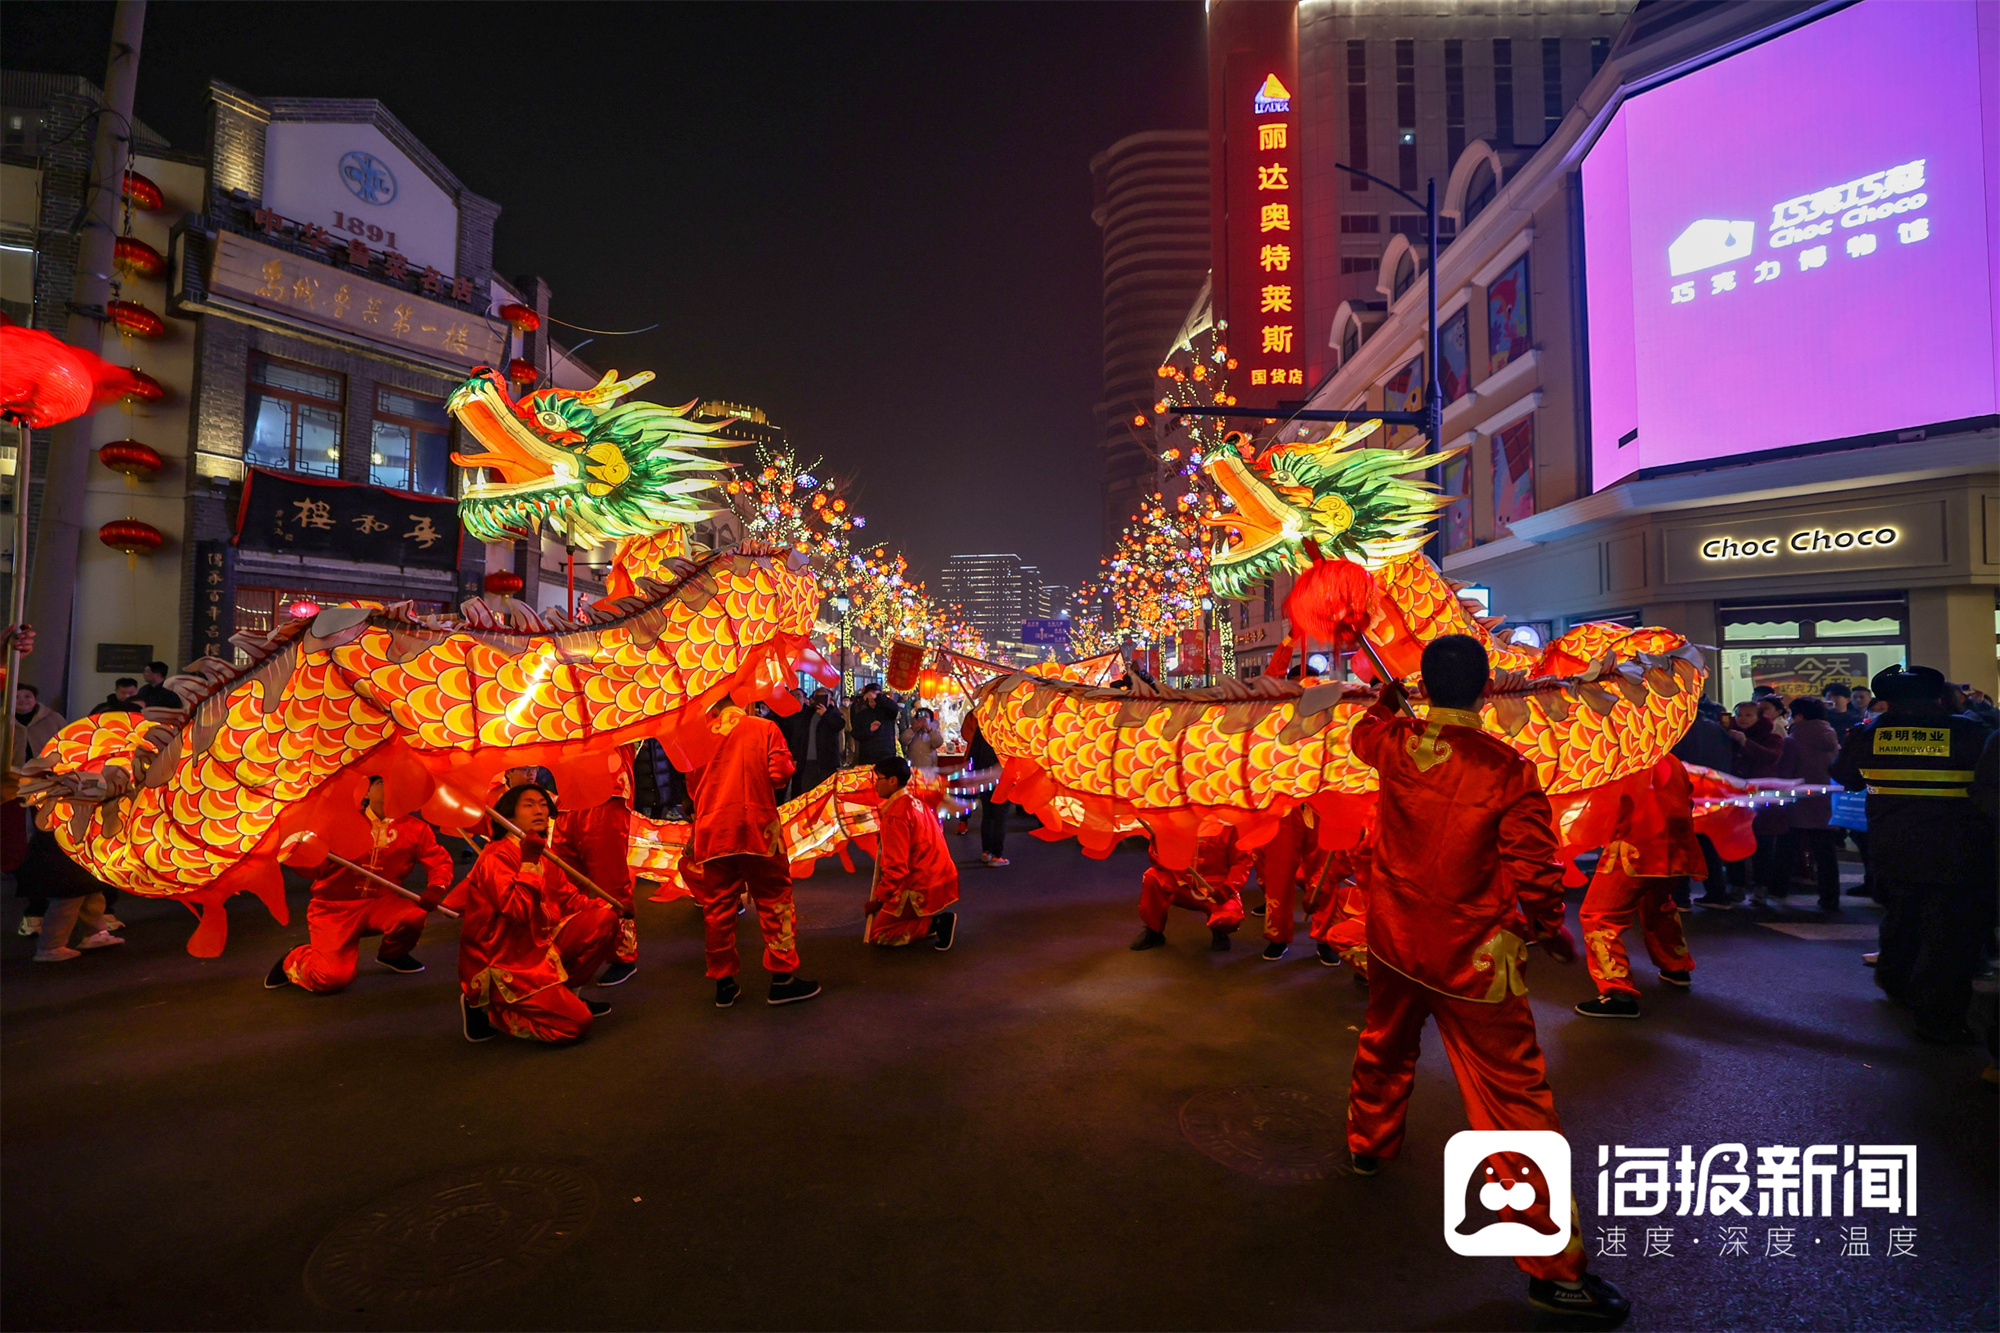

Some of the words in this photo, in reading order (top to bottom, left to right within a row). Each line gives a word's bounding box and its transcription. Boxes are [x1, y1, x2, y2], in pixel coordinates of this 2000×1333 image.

[333, 211, 398, 250] 1891
[1258, 123, 1292, 353] 丽达奥特莱斯
[1769, 219, 1833, 248] Choc
[1840, 193, 1928, 228] Choco
[255, 207, 473, 303] 中华鲁菜名店
[1671, 218, 1929, 304] 巧克力博物馆
[1251, 368, 1303, 386] 国货店
[1702, 538, 1777, 558] Choc
[1790, 527, 1897, 551] Choco
[1794, 657, 1850, 682] 今天
[1781, 683, 1819, 694] 巧克力
[1878, 730, 1945, 742] 海明物业
